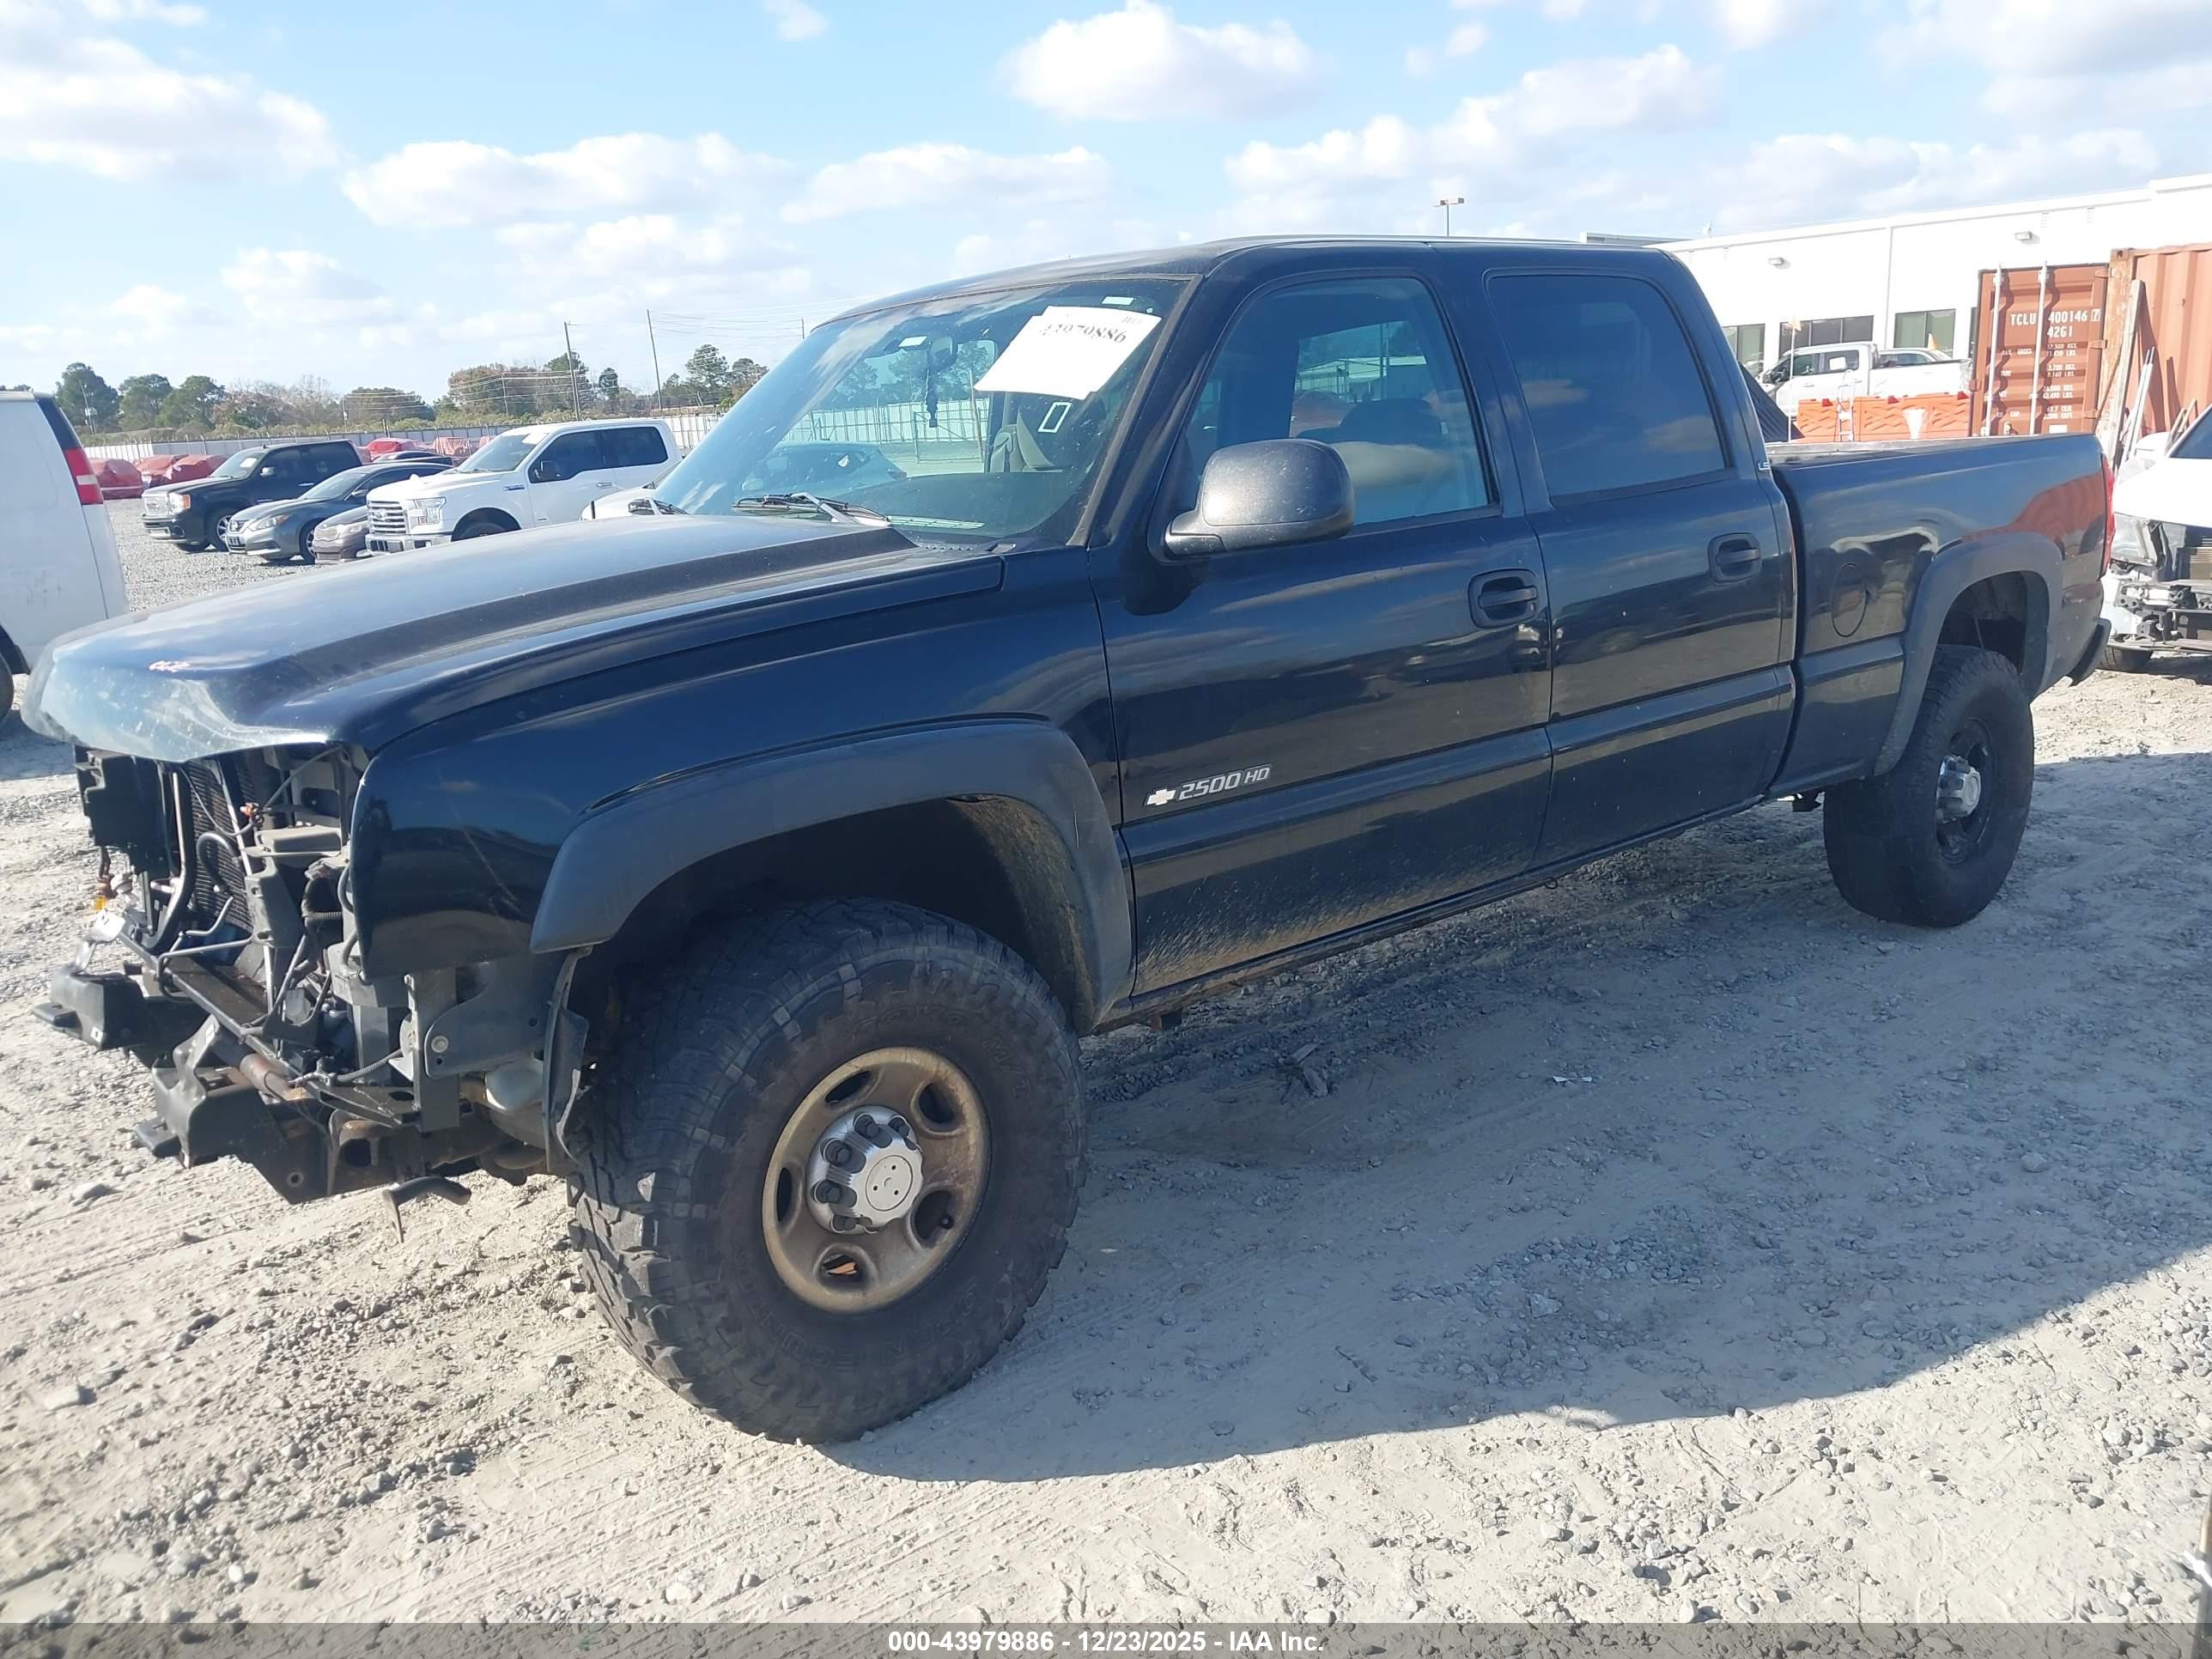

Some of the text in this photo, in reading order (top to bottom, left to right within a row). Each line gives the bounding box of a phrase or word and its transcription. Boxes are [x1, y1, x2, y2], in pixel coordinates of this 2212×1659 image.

[2010, 313, 2037, 325] TCLU
[2048, 309, 2087, 324] 400146
[1178, 767, 1271, 800] 2500 HD
